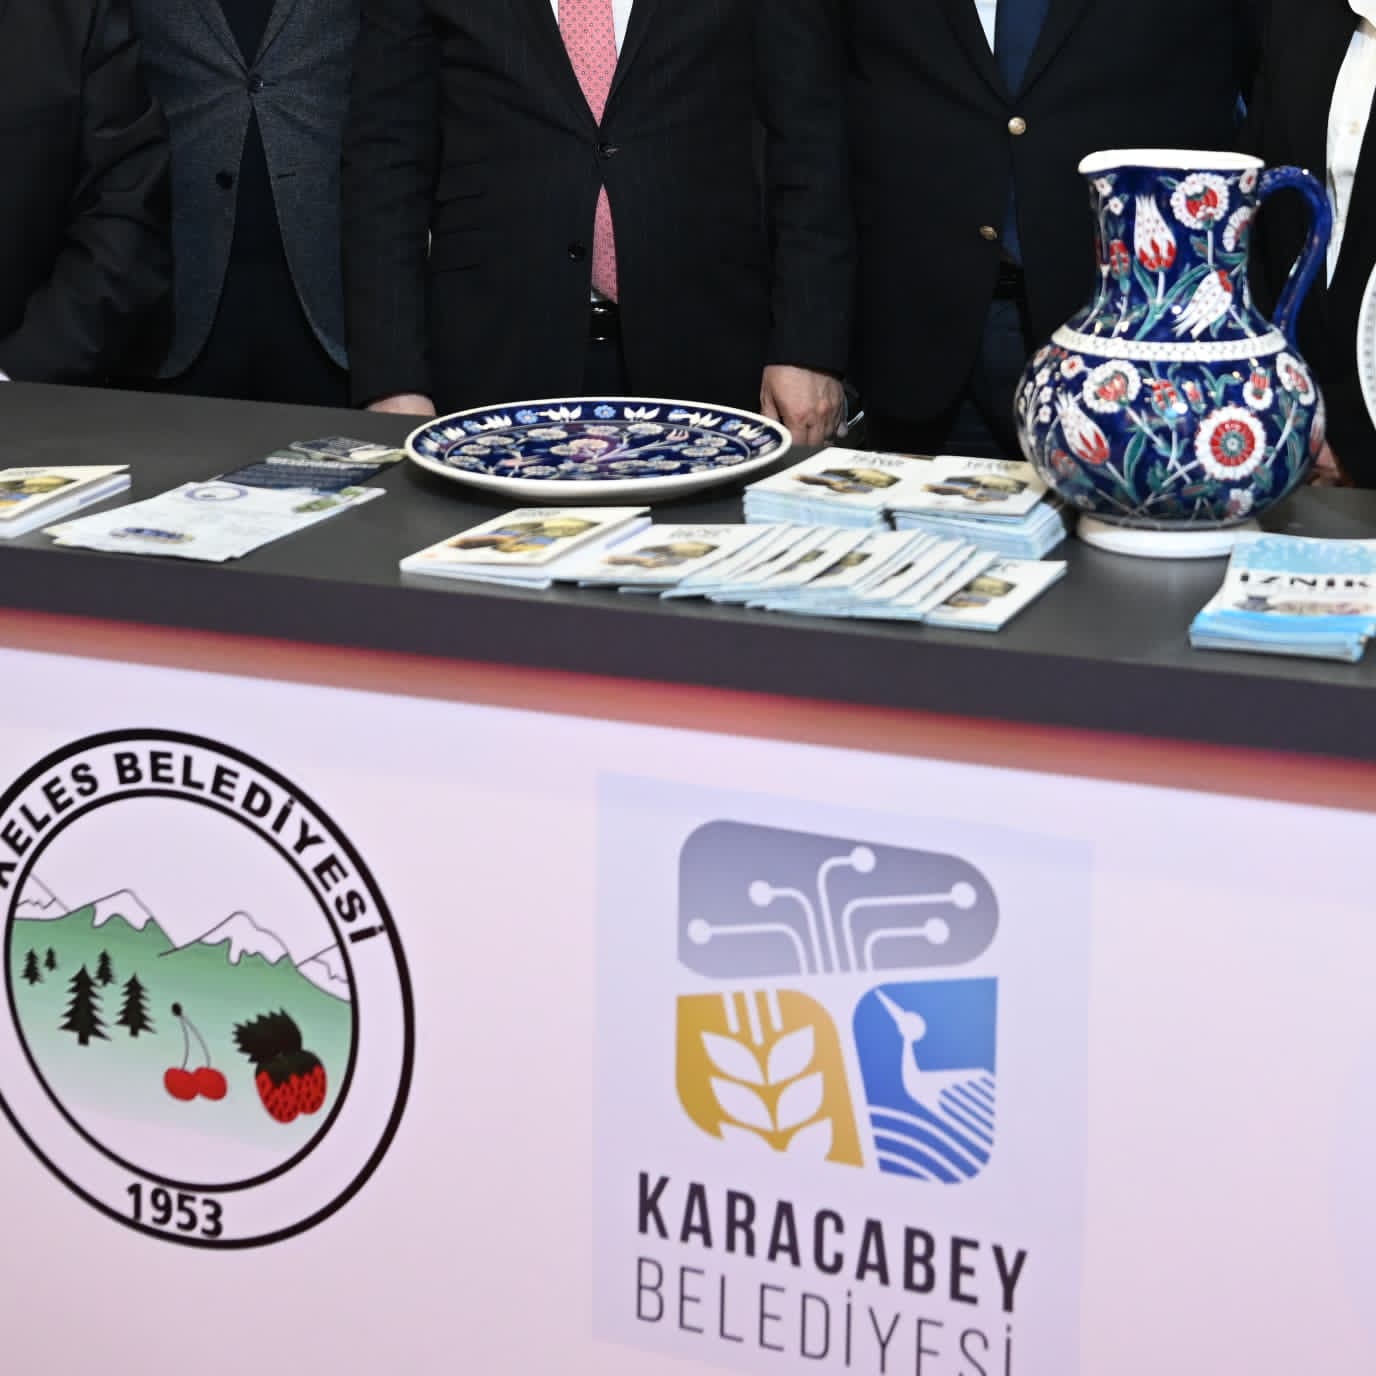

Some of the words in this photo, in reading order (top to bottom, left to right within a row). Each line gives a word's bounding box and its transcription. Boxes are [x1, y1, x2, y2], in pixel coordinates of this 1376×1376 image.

[113, 750, 388, 945] BELEDİYESİ
[126, 1182, 225, 1240] 1953
[636, 1171, 1028, 1313] KARACABEY
